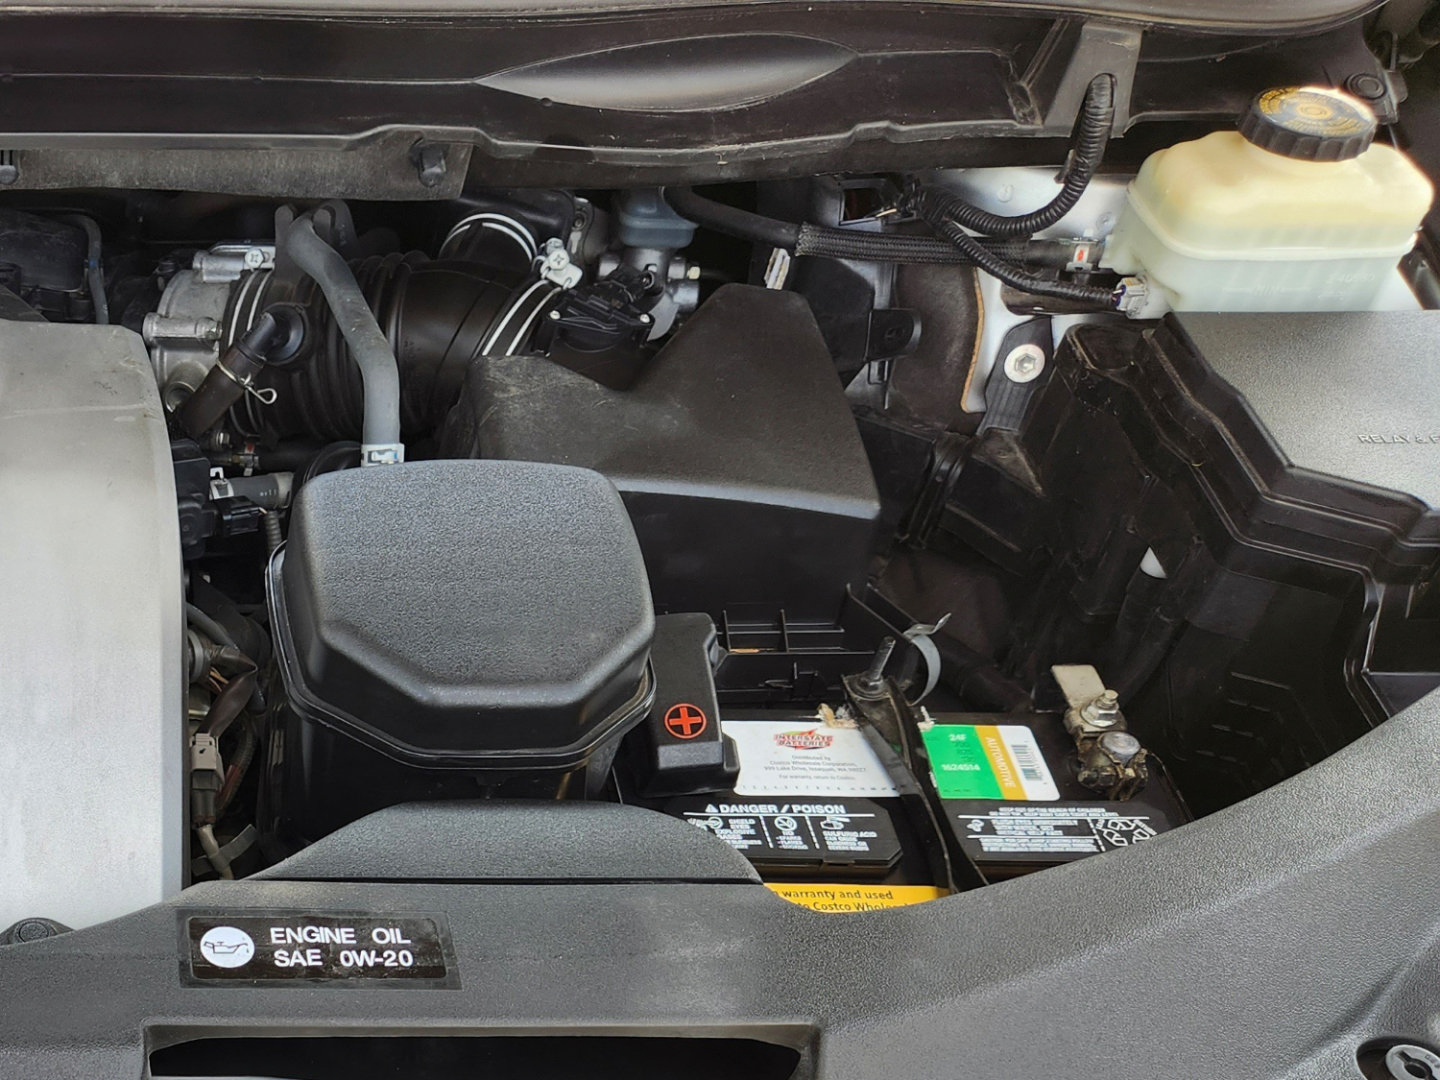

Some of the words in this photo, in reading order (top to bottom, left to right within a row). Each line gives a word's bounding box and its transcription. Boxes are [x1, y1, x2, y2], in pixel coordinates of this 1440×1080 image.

[1357, 434, 1410, 444] RELAY
[774, 733, 833, 742] INTERSTATE
[985, 736, 1016, 788] AUTOMOTIVE
[719, 804, 779, 813] DANGER
[791, 804, 846, 814] POISON
[782, 890, 835, 900] warranty
[840, 890, 861, 899] and
[865, 890, 894, 900] used
[813, 902, 852, 911] Costco
[270, 927, 356, 944] ENGINE
[372, 927, 411, 945] OIL
[273, 950, 323, 967] SAE
[340, 950, 414, 967] 0W-20
